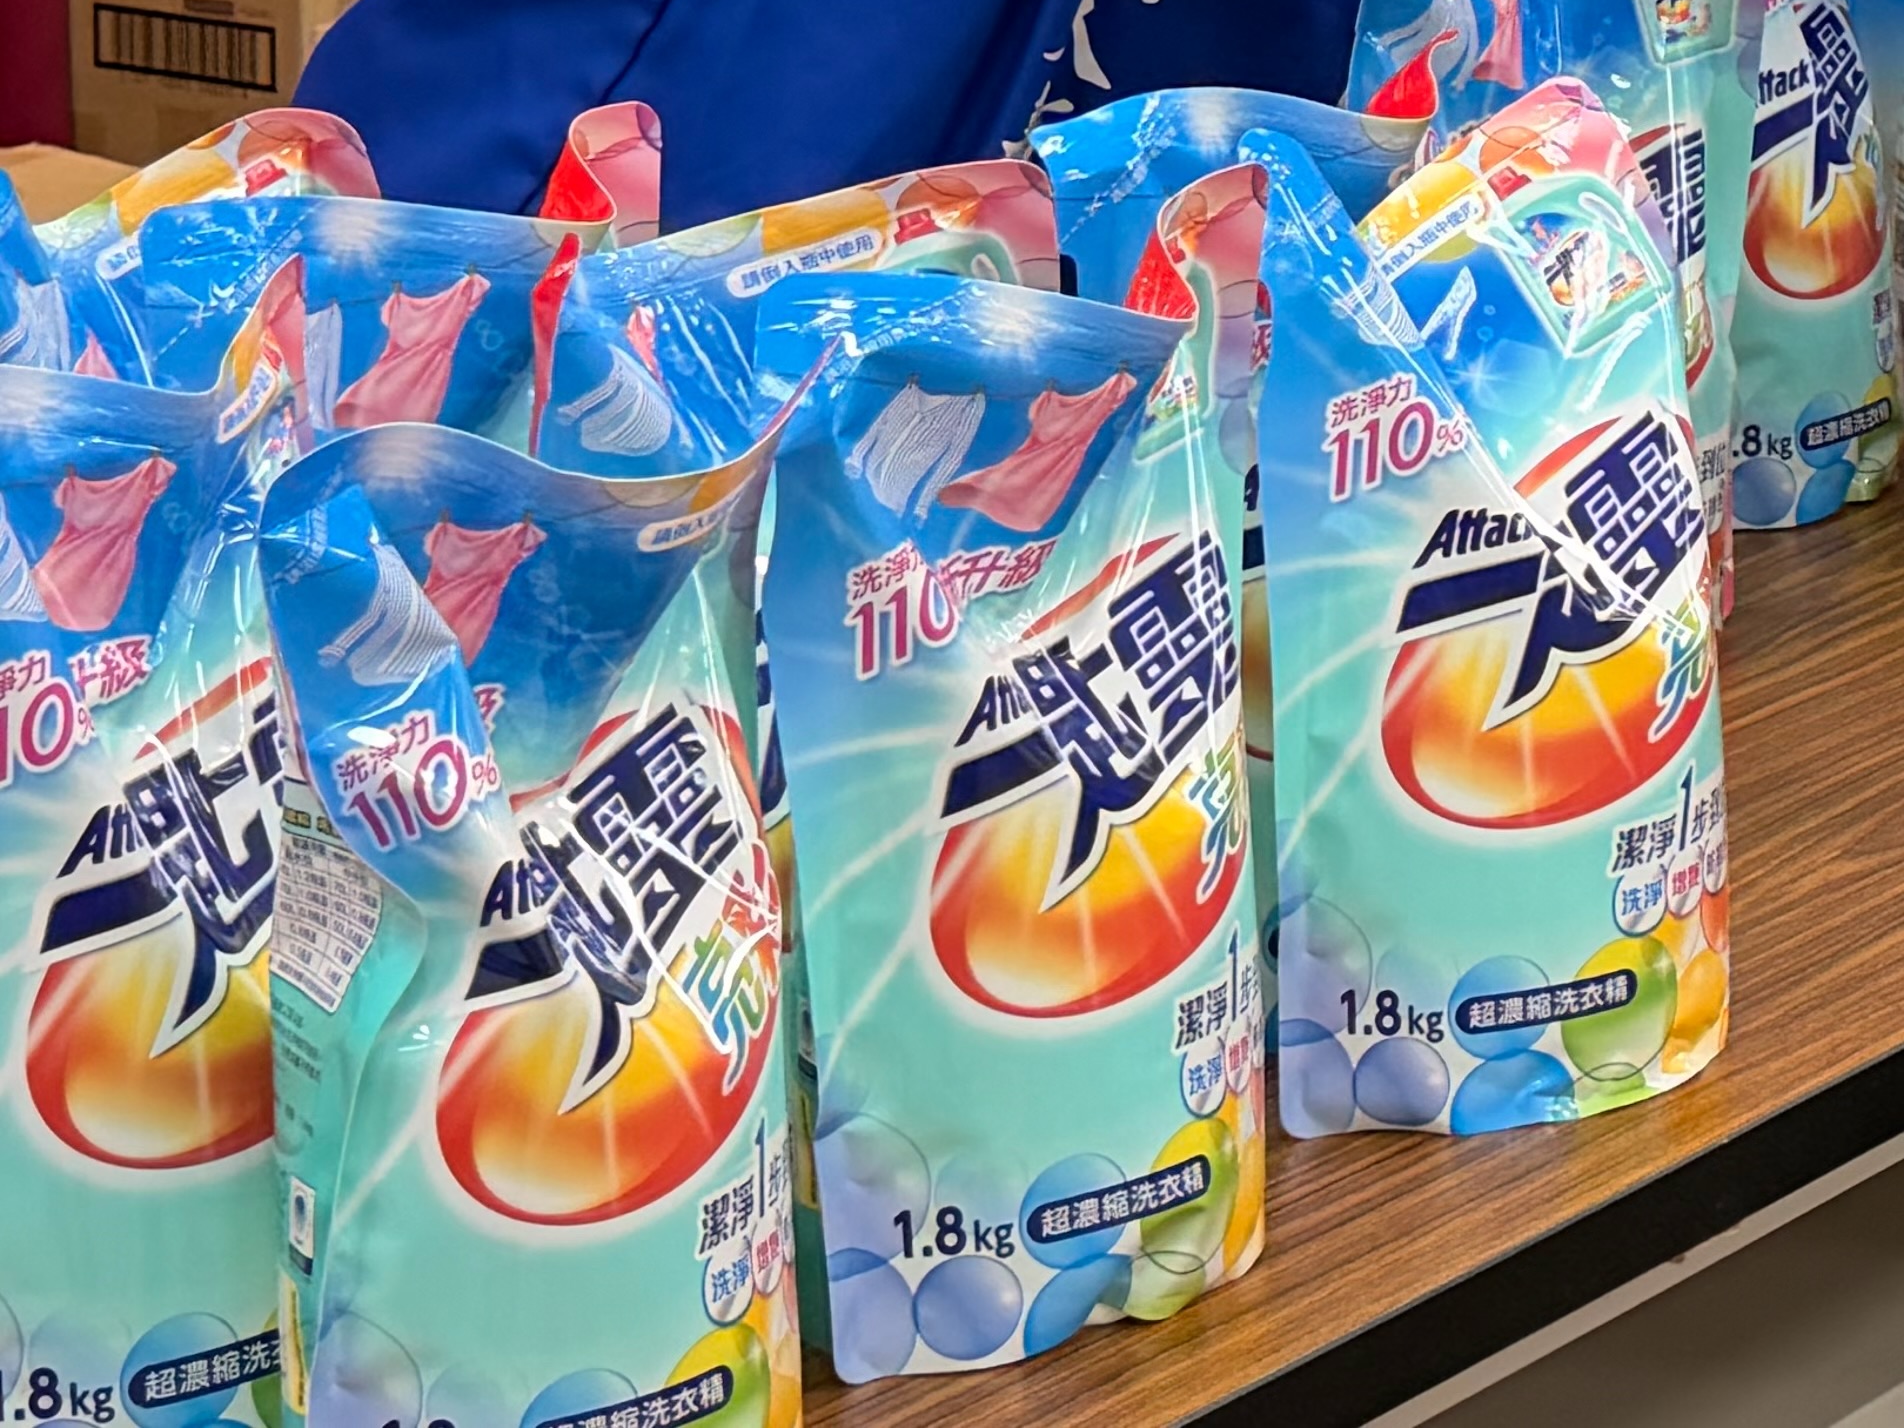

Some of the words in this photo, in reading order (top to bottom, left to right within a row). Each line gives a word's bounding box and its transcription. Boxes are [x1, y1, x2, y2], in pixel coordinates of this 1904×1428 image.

[1757, 58, 1812, 108] ttack
[1331, 376, 1412, 428] 洗淨力
[1327, 401, 1465, 497] 110%
[347, 739, 498, 848] 110%
[1621, 879, 1663, 916] 洗淨
[1468, 974, 1629, 1030] 超濃縮洗衣精
[1040, 1162, 1205, 1238] 超濃縮洗衣精
[547, 1372, 726, 1428] 濃縮洗衣精
